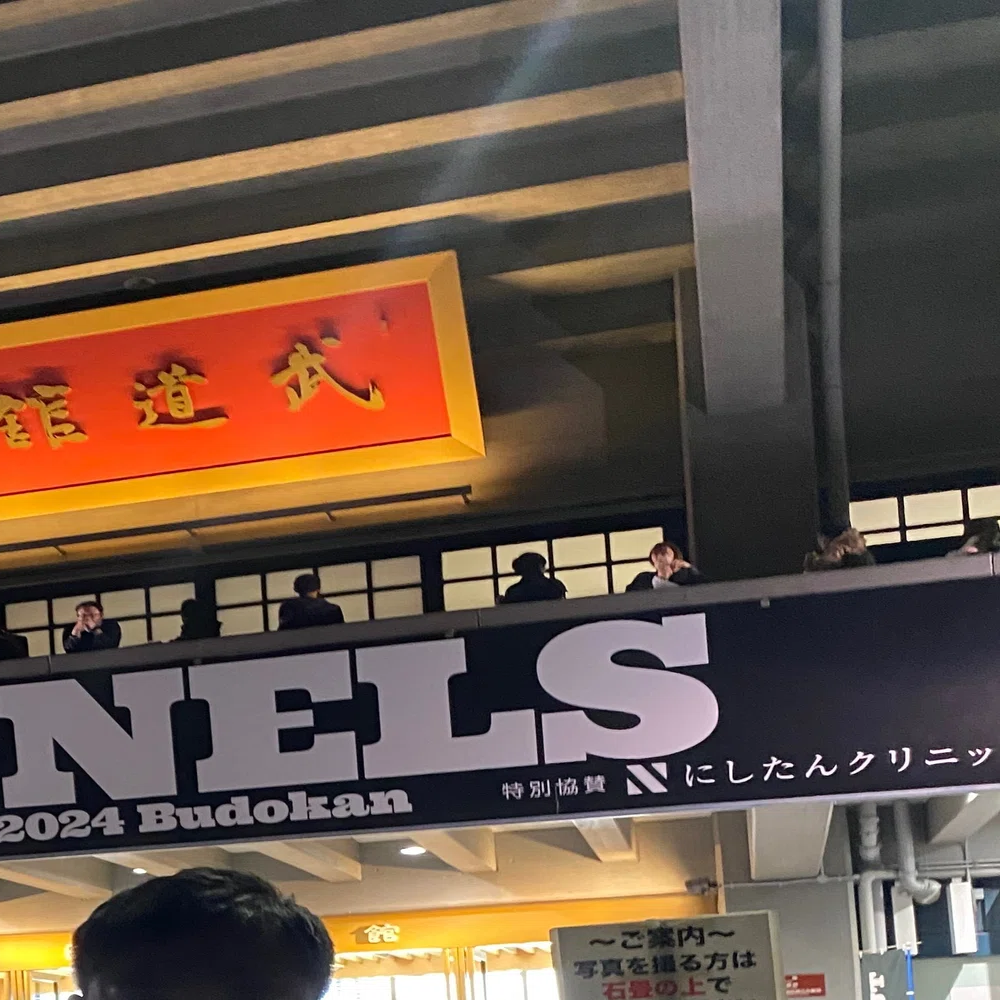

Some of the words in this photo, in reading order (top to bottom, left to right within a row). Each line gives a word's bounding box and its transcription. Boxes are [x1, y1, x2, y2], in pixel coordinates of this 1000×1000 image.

[685, 746, 995, 787] にしたんクリニッ
[502, 774, 606, 800] 特別協賛
[137, 788, 412, 833] Budokan
[574, 951, 757, 979] 写真を撮る方は
[602, 975, 732, 1000] 石畳の上で
